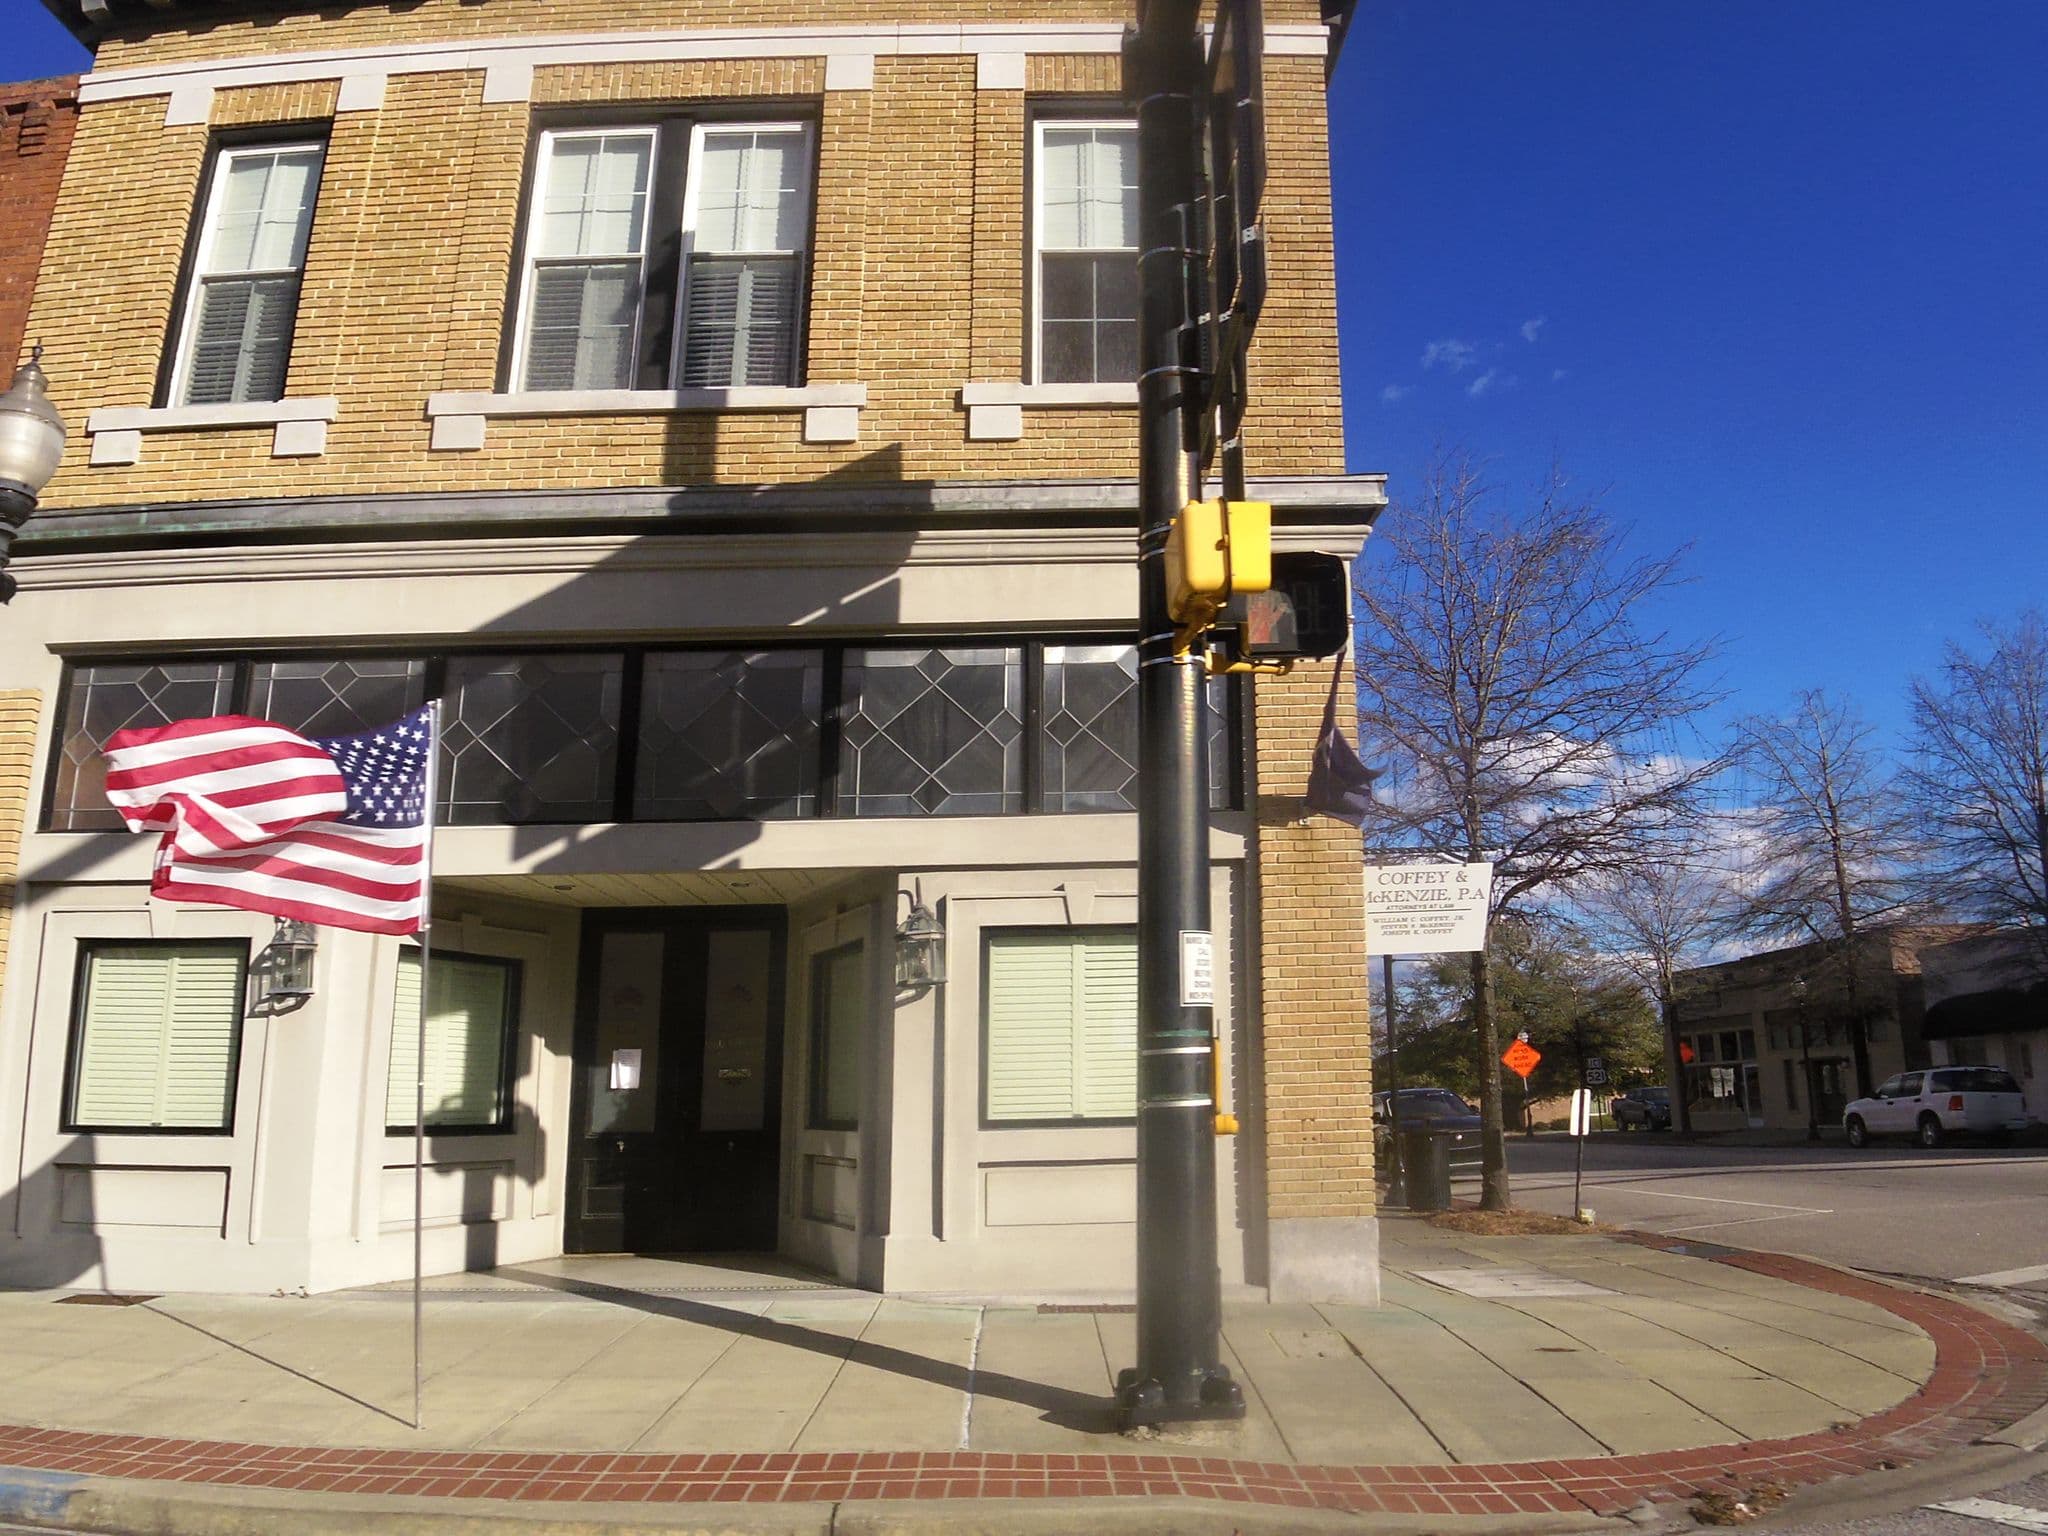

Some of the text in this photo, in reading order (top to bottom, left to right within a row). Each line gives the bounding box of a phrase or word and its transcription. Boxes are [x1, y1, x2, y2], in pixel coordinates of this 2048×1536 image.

[1379, 871, 1467, 885] COFFEY &
[1588, 1071, 1605, 1082] 521
